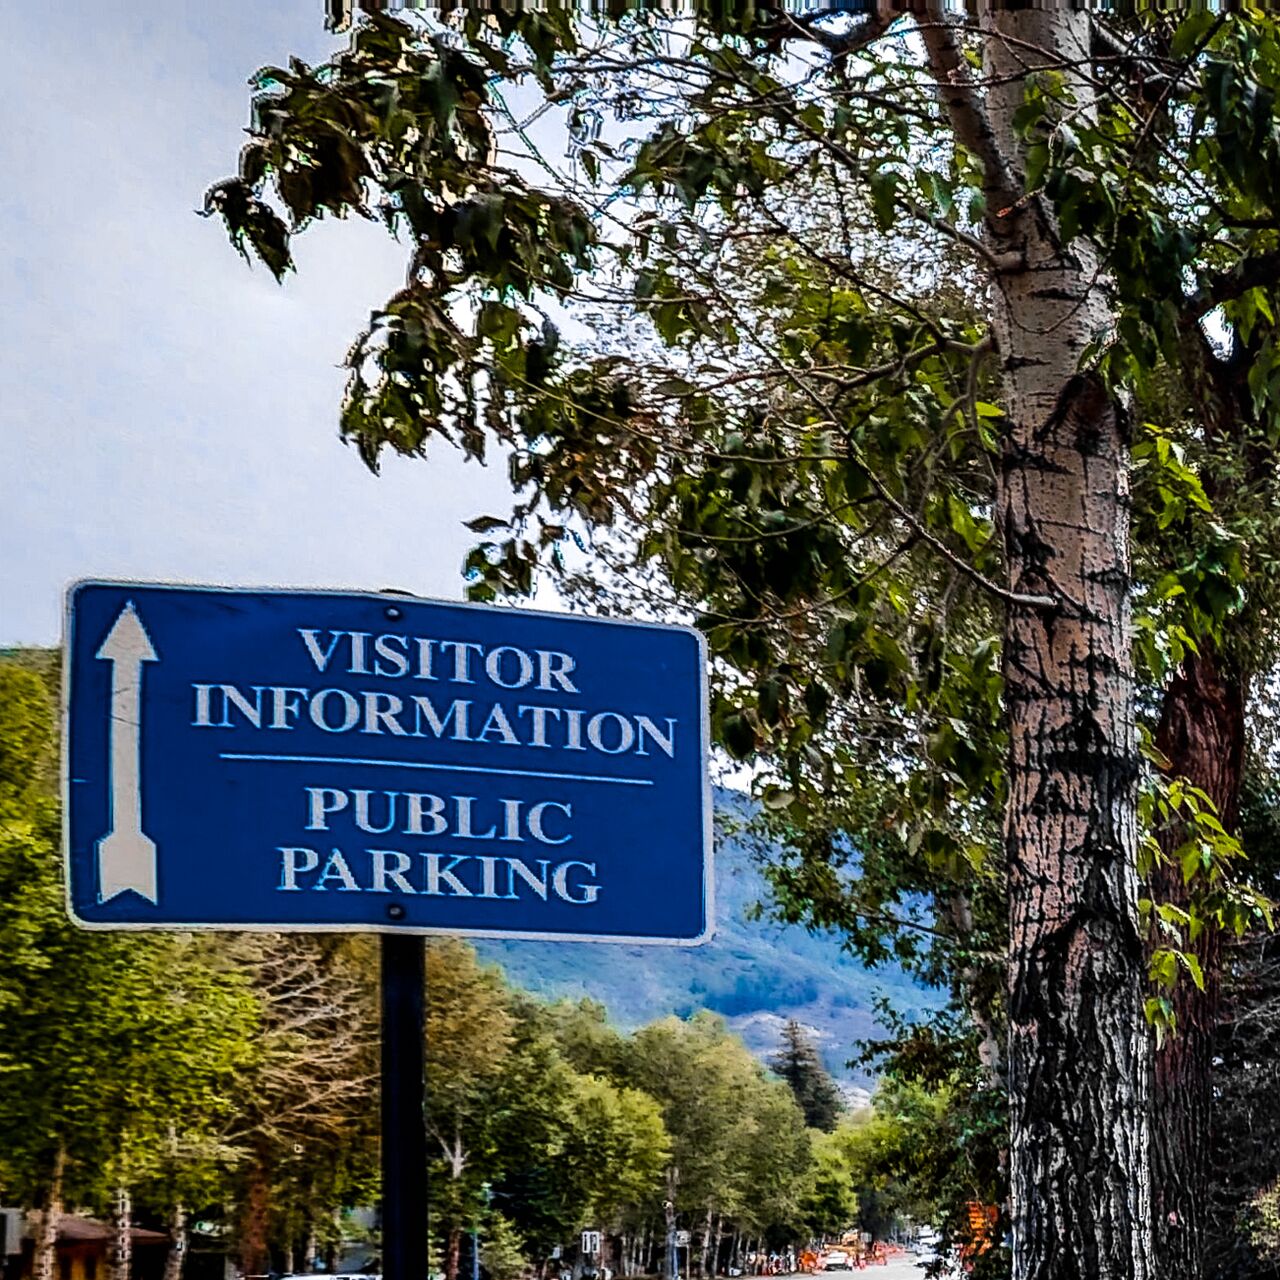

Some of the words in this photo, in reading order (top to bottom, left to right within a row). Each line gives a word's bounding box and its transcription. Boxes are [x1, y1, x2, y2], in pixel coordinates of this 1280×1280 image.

[297, 628, 580, 694] VISITOR
[191, 682, 679, 759] INFORMATION
[304, 786, 573, 844] PUBLIC
[277, 846, 602, 904] PARKING
